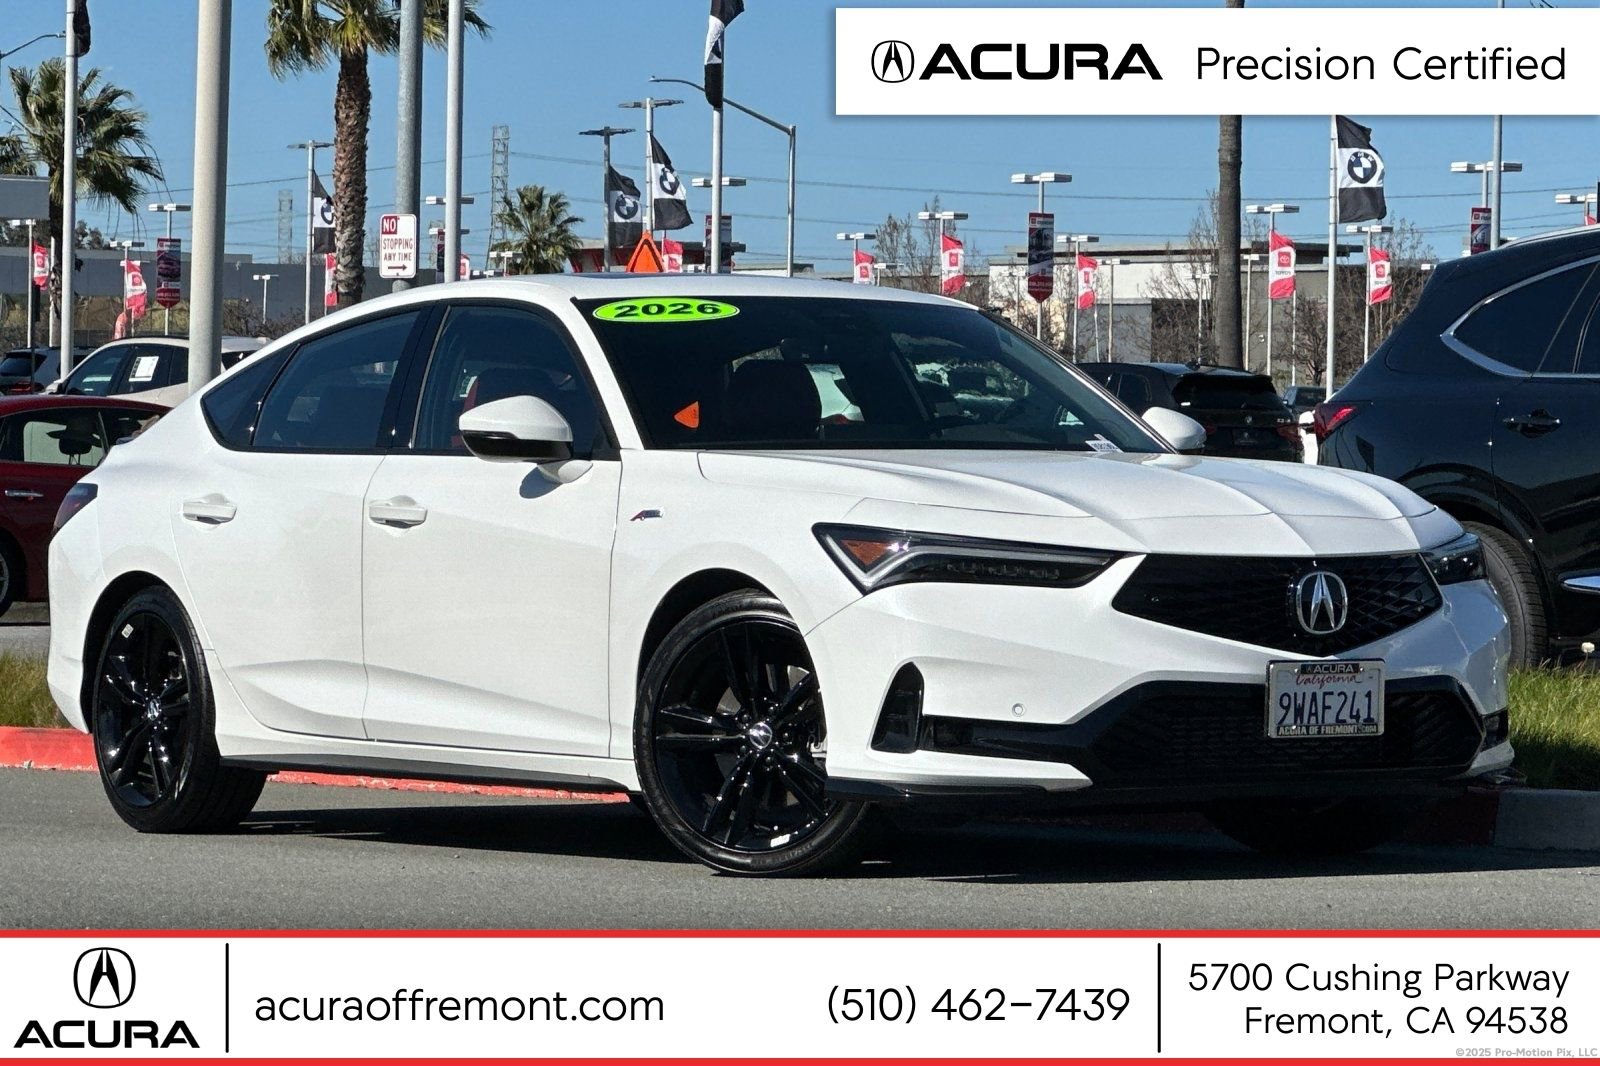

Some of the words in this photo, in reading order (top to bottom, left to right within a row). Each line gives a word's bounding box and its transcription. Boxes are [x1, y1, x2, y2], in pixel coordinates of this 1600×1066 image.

[383, 218, 397, 232] NO
[382, 238, 414, 250] STOPPING
[383, 252, 396, 261] ANY
[398, 252, 412, 261] TIME
[614, 303, 721, 318] 2026
[1313, 664, 1354, 673] ACURA
[1296, 674, 1362, 689] California
[1278, 690, 1375, 725] 9WAF241
[1309, 726, 1319, 735] OF
